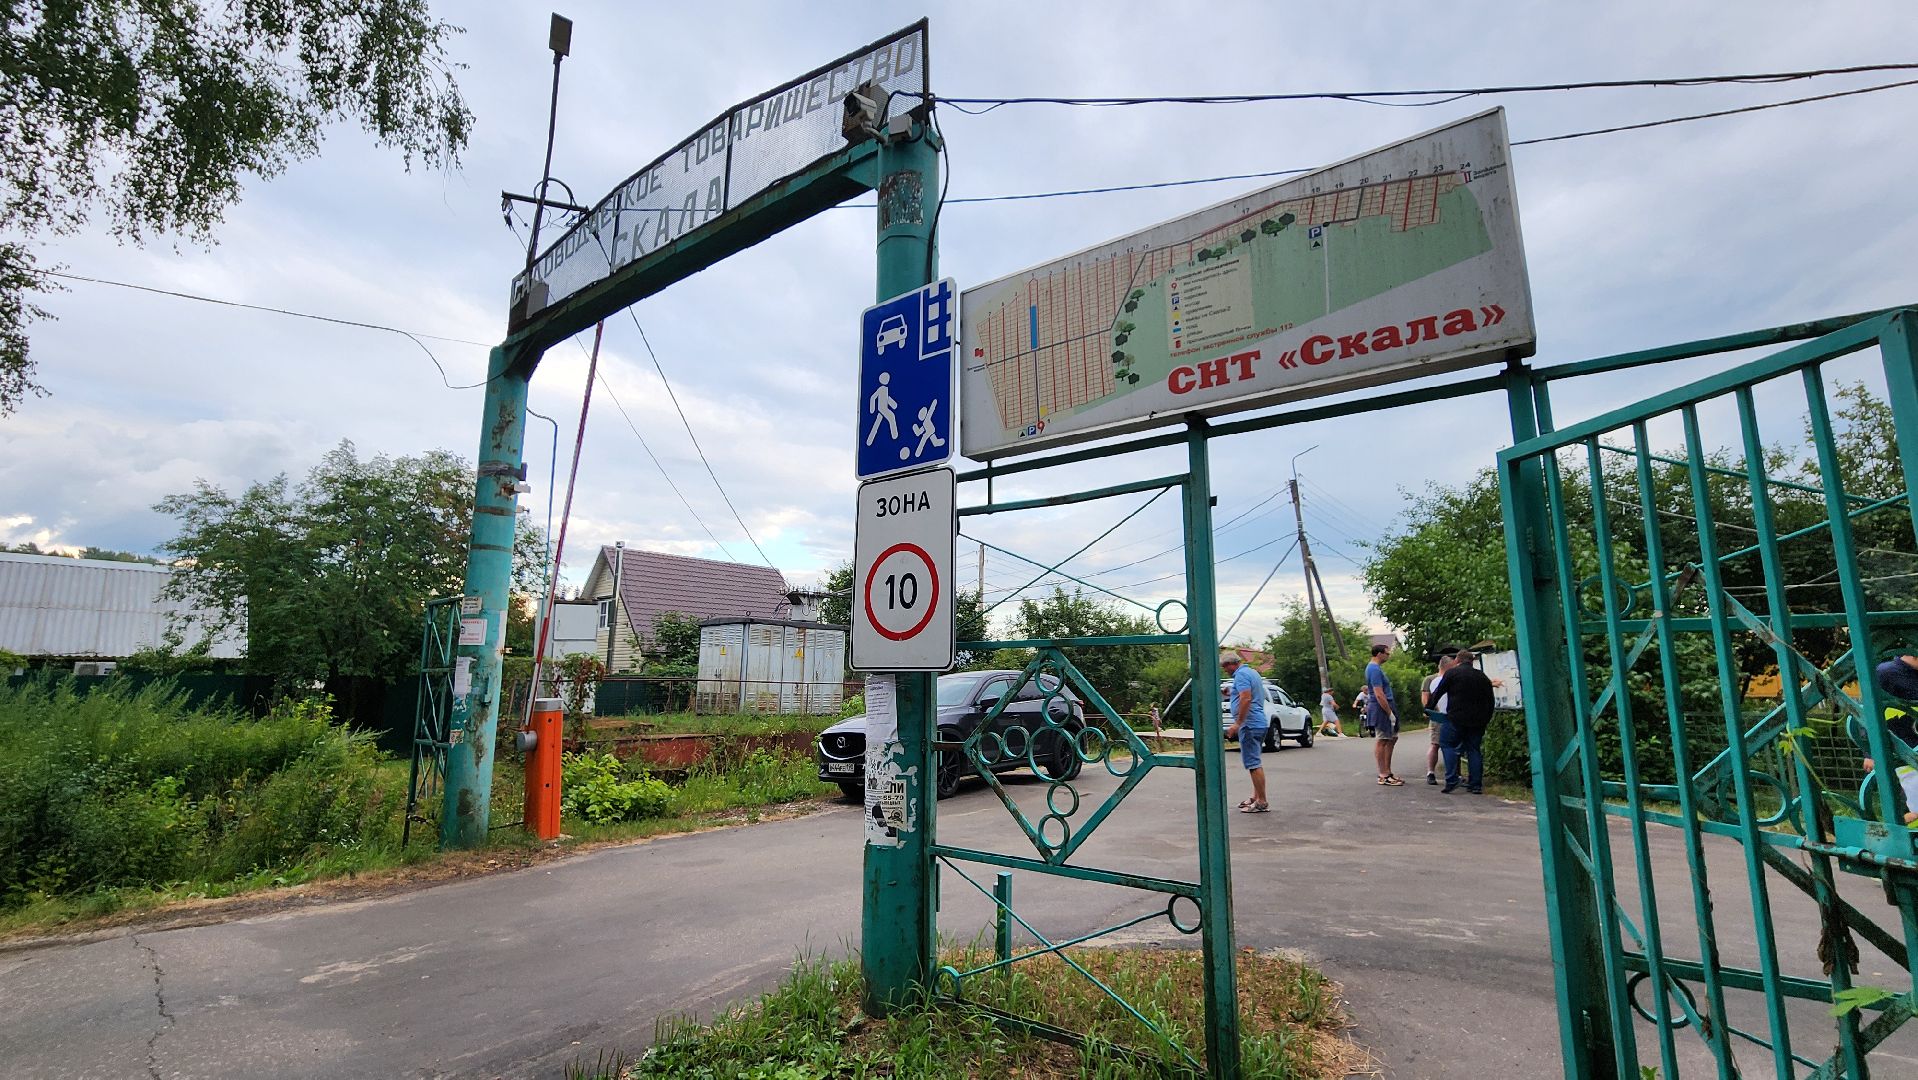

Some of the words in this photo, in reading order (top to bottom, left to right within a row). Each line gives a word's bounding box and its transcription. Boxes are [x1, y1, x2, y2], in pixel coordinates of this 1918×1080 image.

[681, 32, 918, 172] ТОВАРИЩЕСТВО
[1433, 164, 1444, 173] 23
[1460, 161, 1471, 170] 24
[1383, 173, 1393, 182] 21
[1408, 169, 1420, 178] 22
[1335, 182, 1344, 190] 19
[1360, 177, 1370, 185] 20
[611, 175, 722, 273] СКАЛА
[1247, 327, 1277, 339] службы
[1280, 322, 1293, 331] 112
[1168, 350, 1261, 395] СНТ
[1278, 304, 1505, 370] «Скала»
[876, 490, 931, 518] ЗОНА
[885, 572, 917, 610] 10
